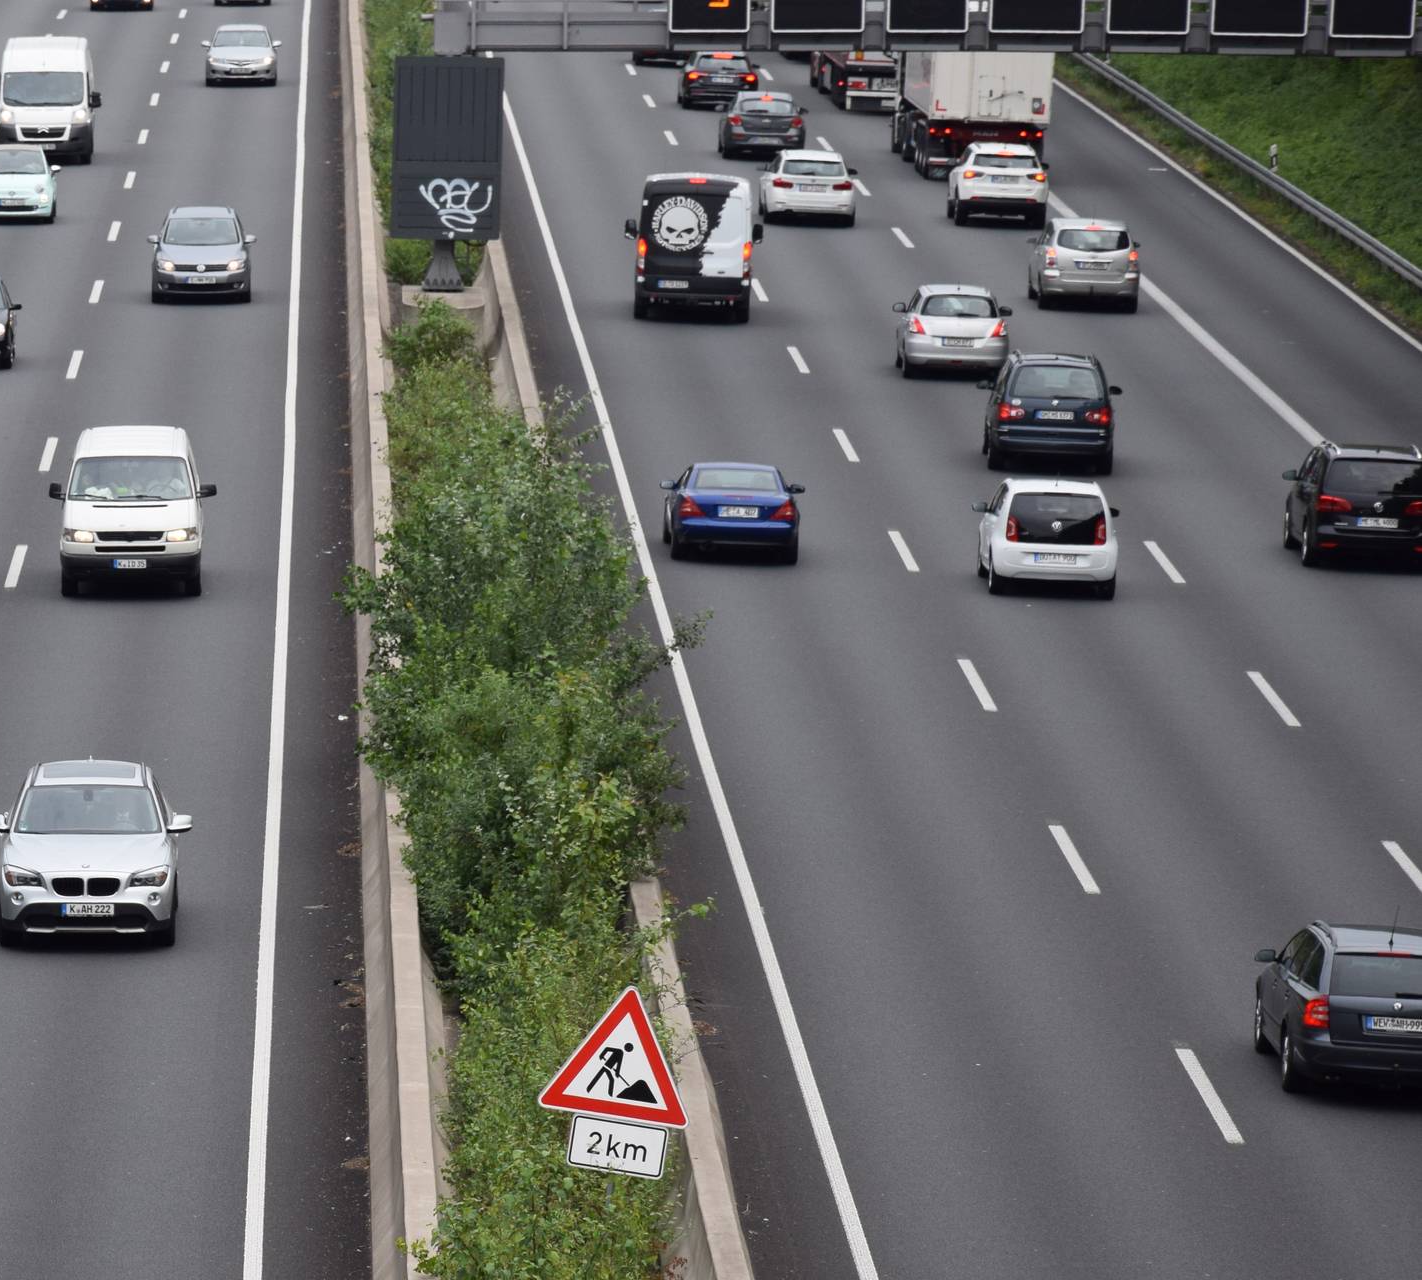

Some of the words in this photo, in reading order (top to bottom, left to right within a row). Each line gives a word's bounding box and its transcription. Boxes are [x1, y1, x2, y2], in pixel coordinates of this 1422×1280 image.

[69, 905, 76, 913] K
[81, 905, 93, 913] AH
[95, 905, 111, 913] 222
